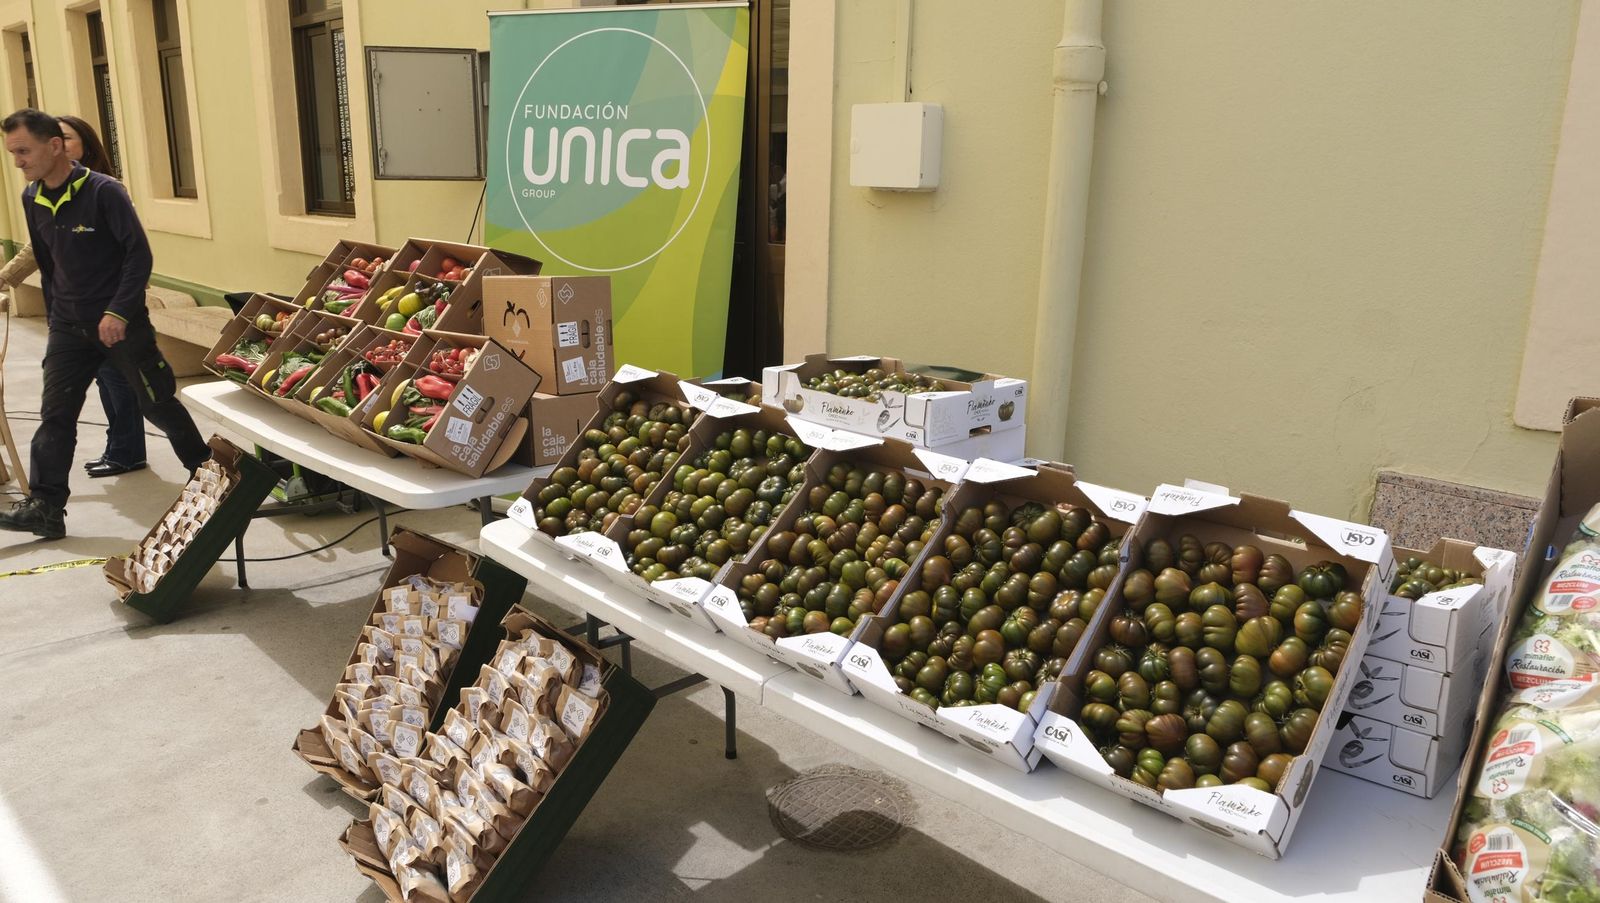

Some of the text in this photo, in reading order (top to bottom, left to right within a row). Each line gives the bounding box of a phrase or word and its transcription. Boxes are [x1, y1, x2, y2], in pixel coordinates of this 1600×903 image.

[524, 101, 629, 120] FUNDACIÓN
[521, 188, 556, 199] GROUP
[587, 359, 598, 385] caja
[542, 426, 552, 437] la
[542, 434, 566, 447] caja
[451, 444, 462, 457] la
[458, 436, 479, 462] caja
[1044, 725, 1069, 742] CASI
